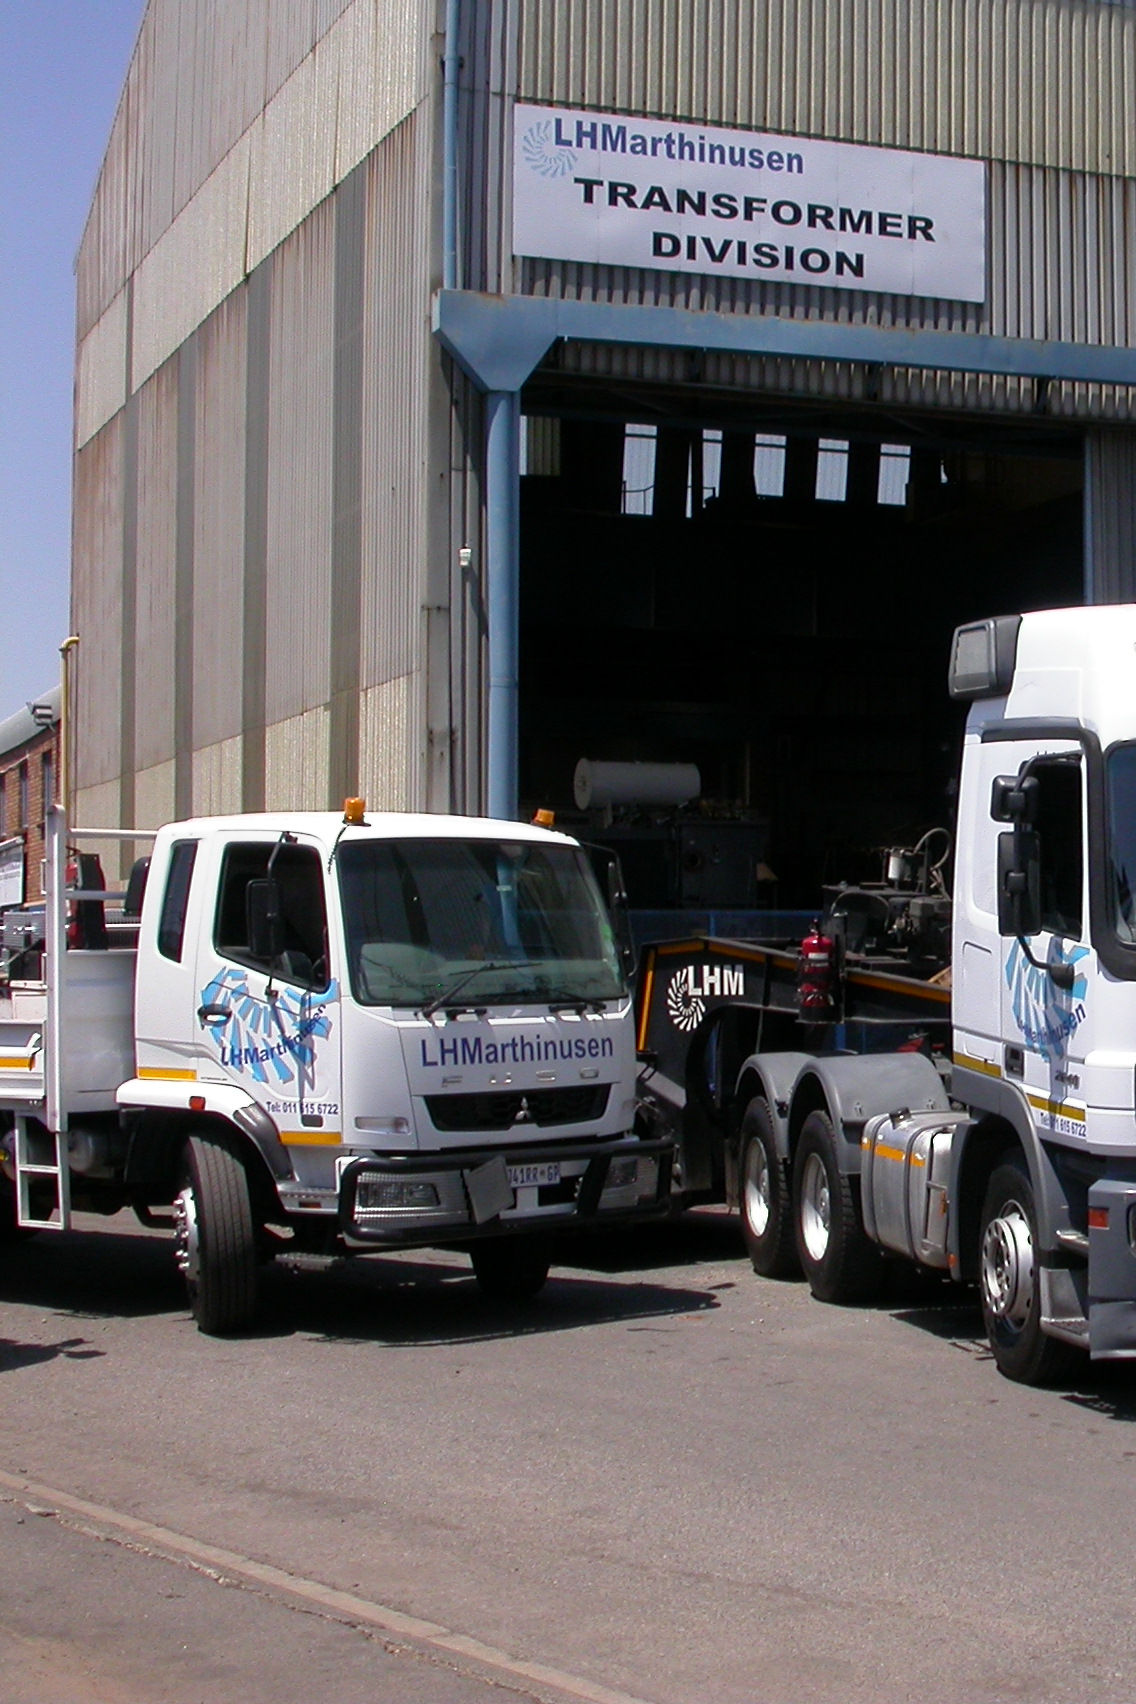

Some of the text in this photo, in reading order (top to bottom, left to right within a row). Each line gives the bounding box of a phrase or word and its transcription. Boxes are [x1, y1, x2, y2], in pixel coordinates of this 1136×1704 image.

[554, 117, 804, 174] LHMarthinusen
[573, 176, 937, 243] TRANSFORMER
[651, 230, 865, 278] DIVISION
[687, 964, 745, 997] LHM
[420, 1034, 614, 1068] LHMarthinusen
[282, 1102, 297, 1114] 011
[317, 1103, 339, 1116] 6722
